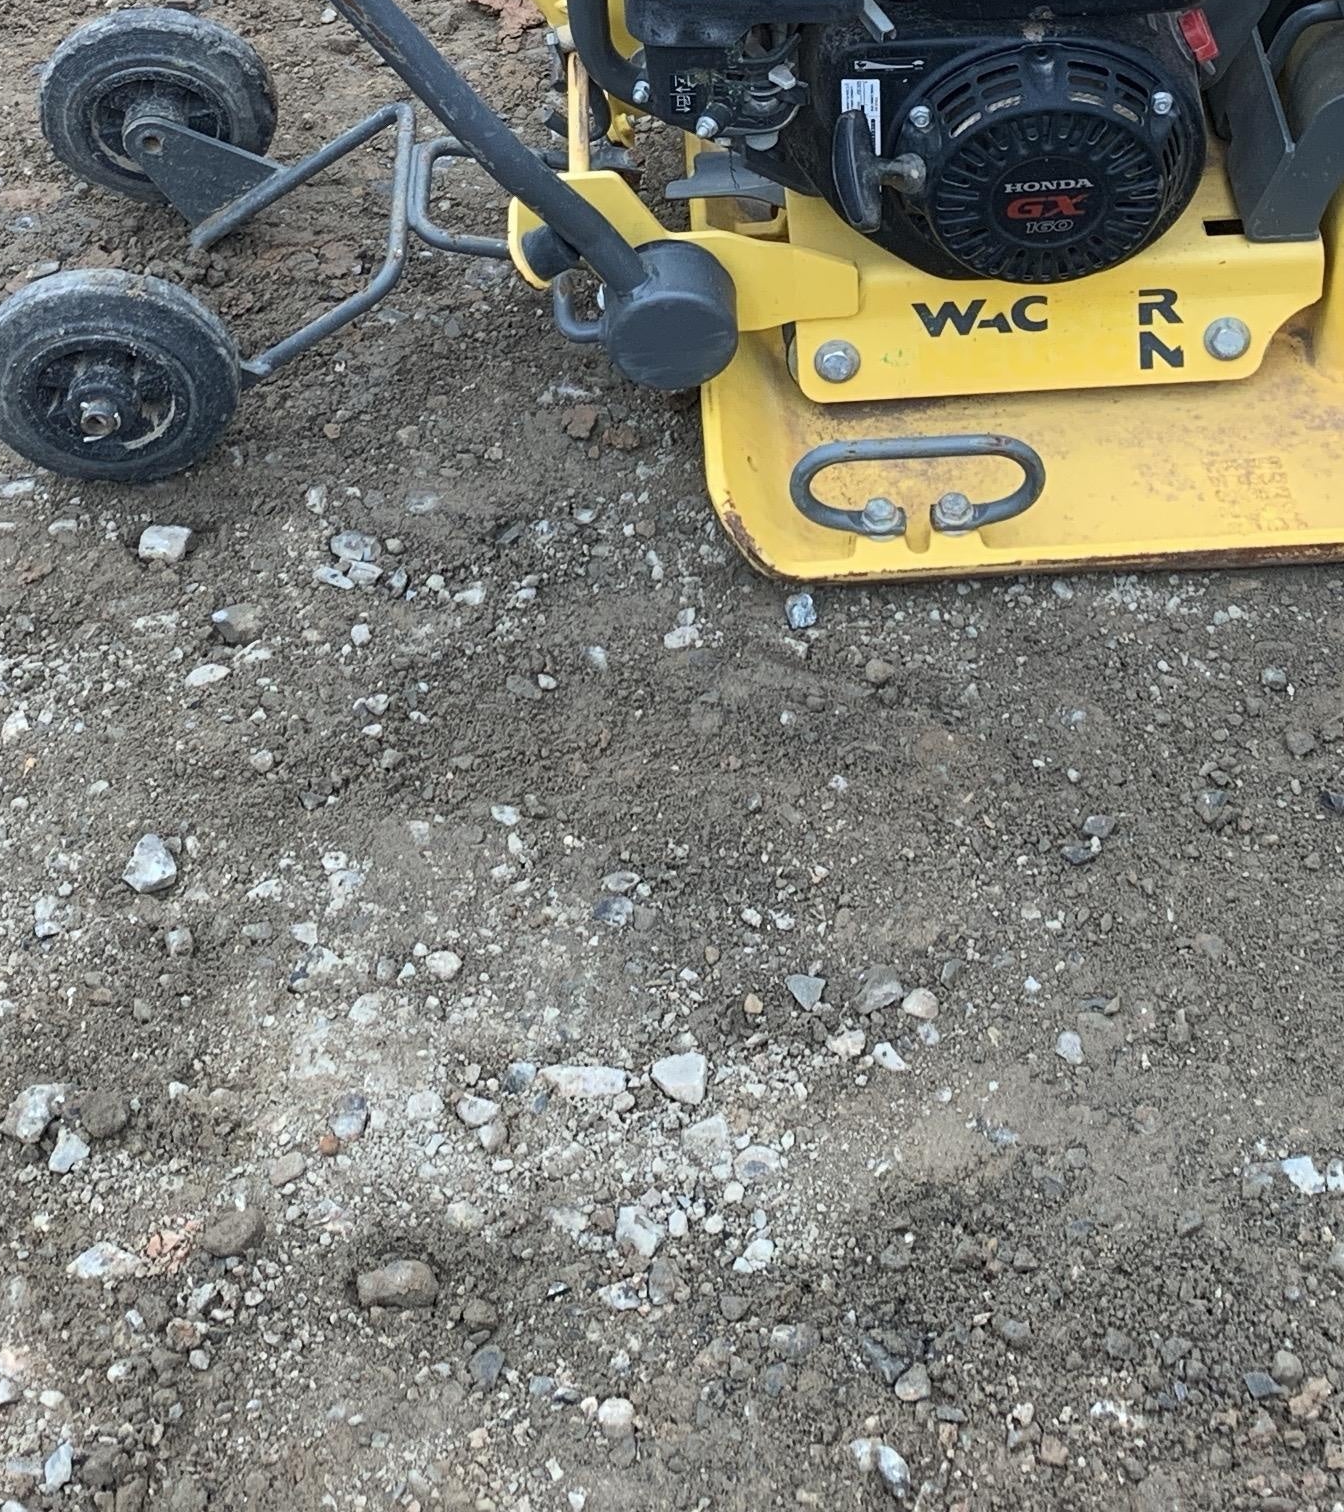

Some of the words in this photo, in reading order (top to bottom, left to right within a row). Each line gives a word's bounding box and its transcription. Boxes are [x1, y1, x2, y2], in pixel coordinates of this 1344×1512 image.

[1004, 178, 1095, 193] HONDA
[1007, 193, 1090, 219] GX
[1025, 219, 1074, 234] 160
